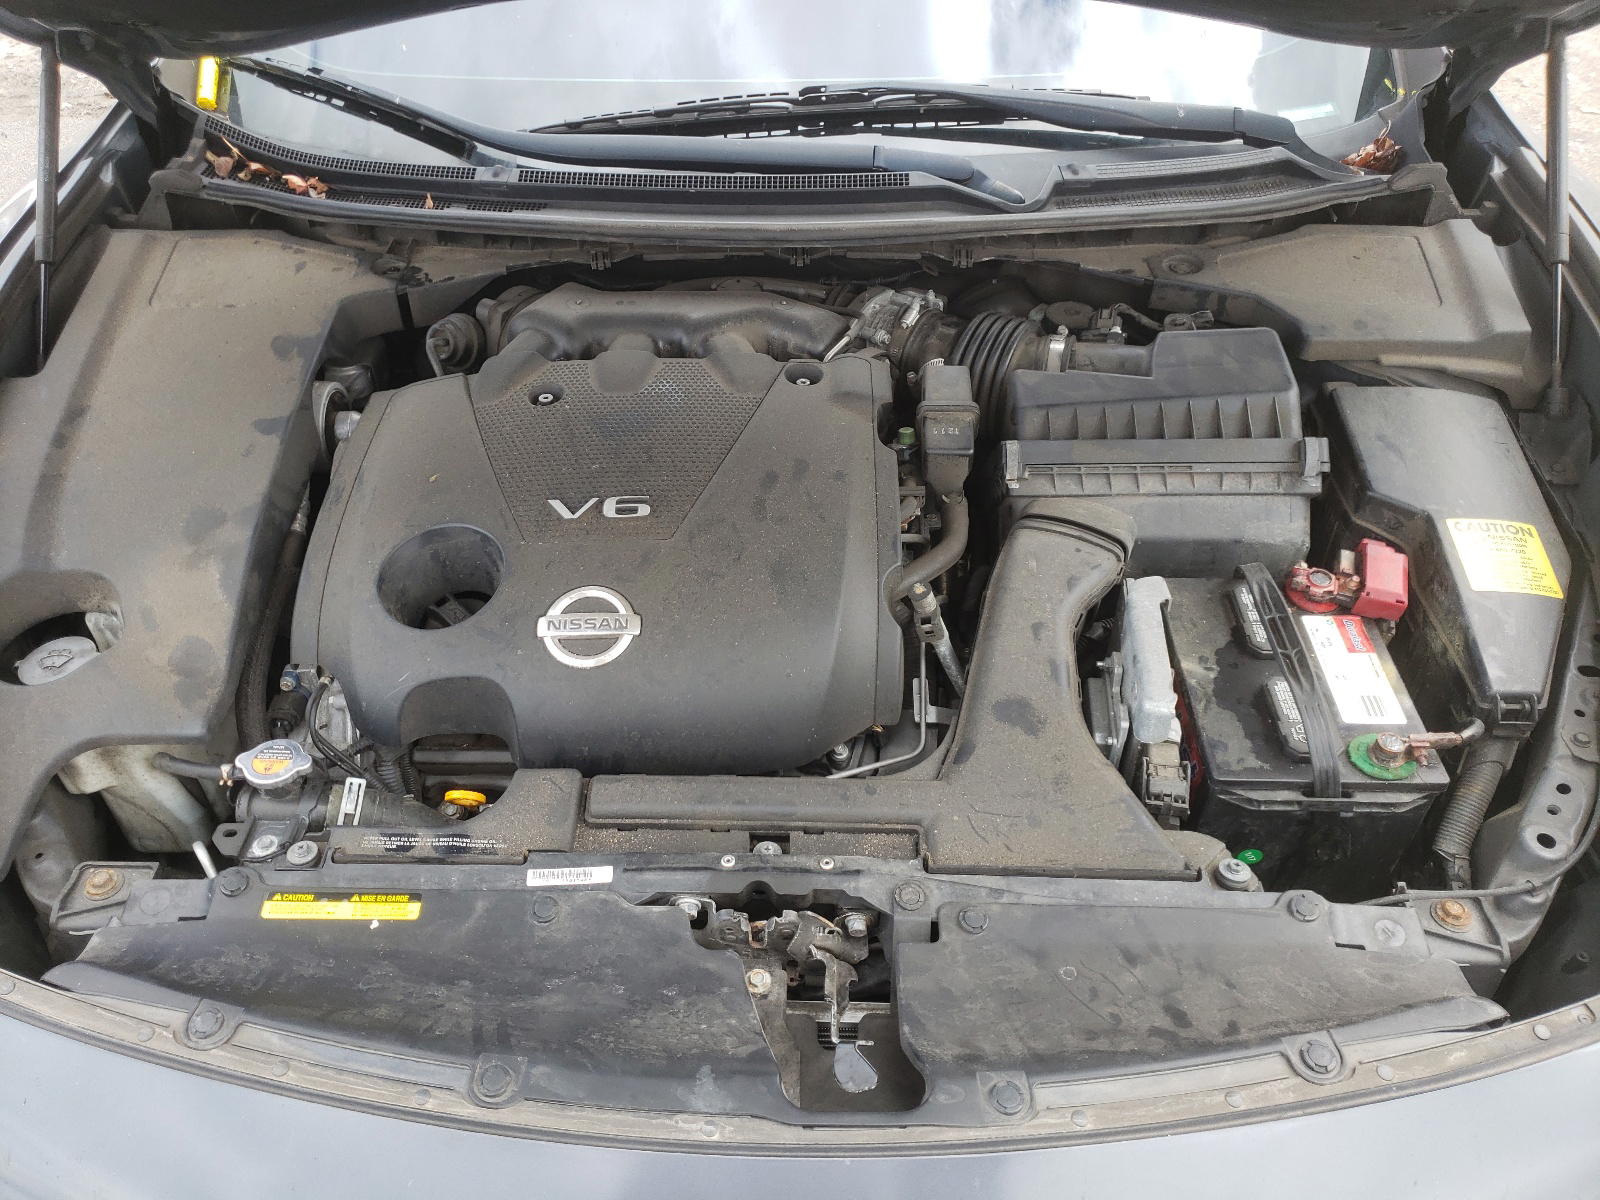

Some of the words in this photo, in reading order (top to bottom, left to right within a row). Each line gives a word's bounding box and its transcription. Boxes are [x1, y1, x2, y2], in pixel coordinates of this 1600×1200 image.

[547, 495, 651, 519] V6
[1454, 521, 1535, 538] CAUTION
[547, 617, 629, 632] NISSAN
[282, 894, 315, 902] CAUTION
